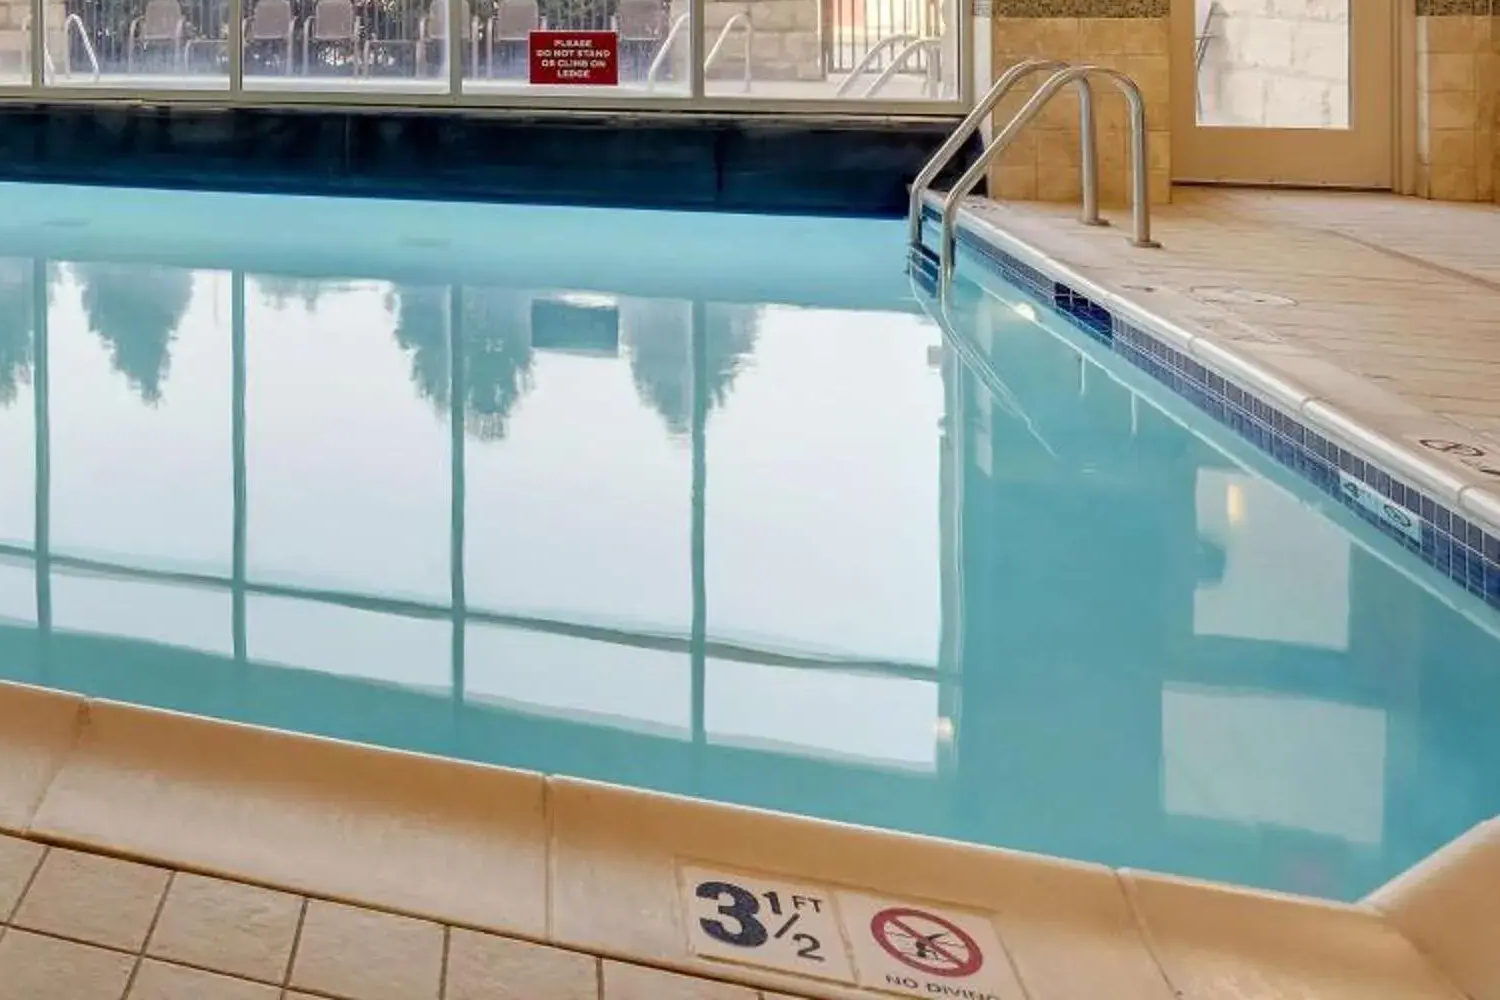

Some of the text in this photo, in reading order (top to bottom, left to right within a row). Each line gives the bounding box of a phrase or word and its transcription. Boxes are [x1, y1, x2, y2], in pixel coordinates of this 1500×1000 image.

[553, 39, 592, 47] PLEASE
[536, 49, 611, 58] DO NOT STAND
[557, 60, 589, 68] CLIMB
[590, 60, 607, 68] ON
[557, 70, 590, 78] LEDGE
[792, 895, 822, 913] FT
[885, 974, 919, 990] NO
